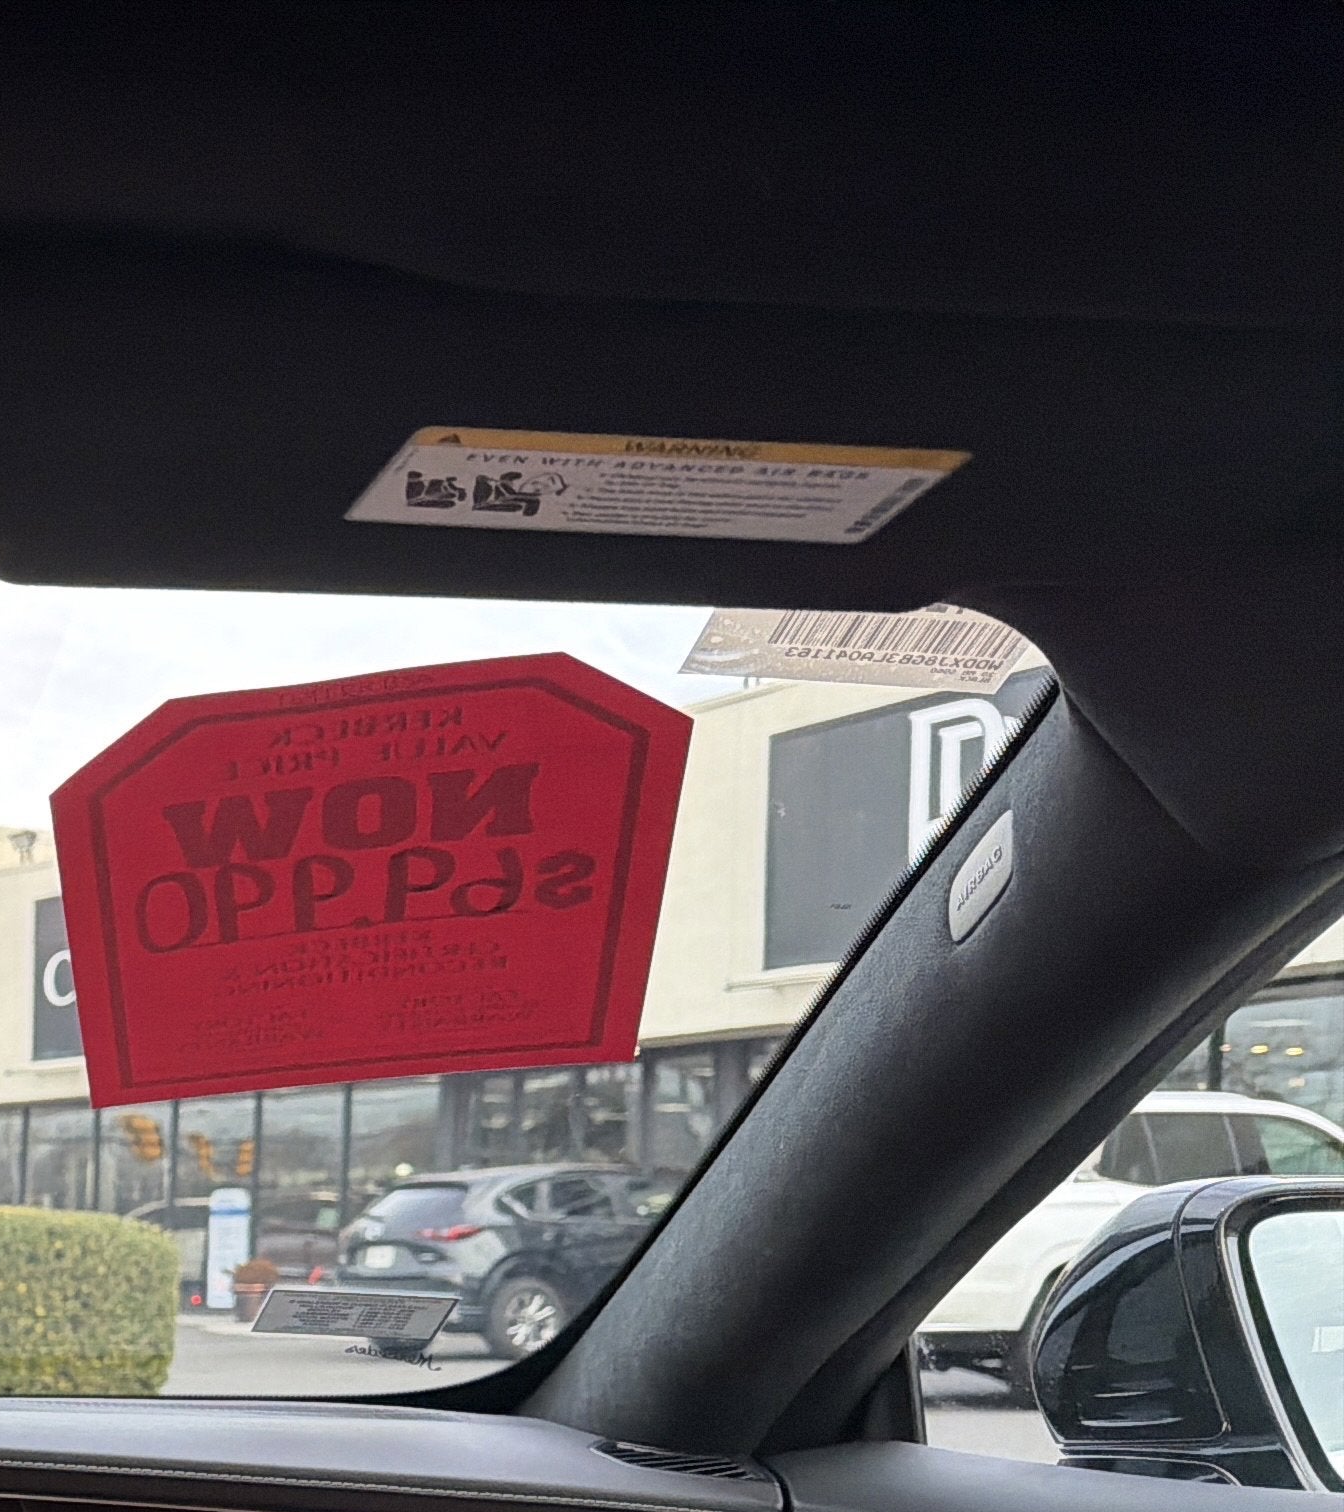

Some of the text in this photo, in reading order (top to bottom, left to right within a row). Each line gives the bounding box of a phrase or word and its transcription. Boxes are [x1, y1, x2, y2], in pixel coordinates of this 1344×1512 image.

[624, 439, 761, 460] WARNING
[467, 451, 533, 466] EVEN
[540, 454, 604, 469] WITH
[613, 457, 747, 476] ADVANCED
[957, 846, 1002, 911] AIRBAG
